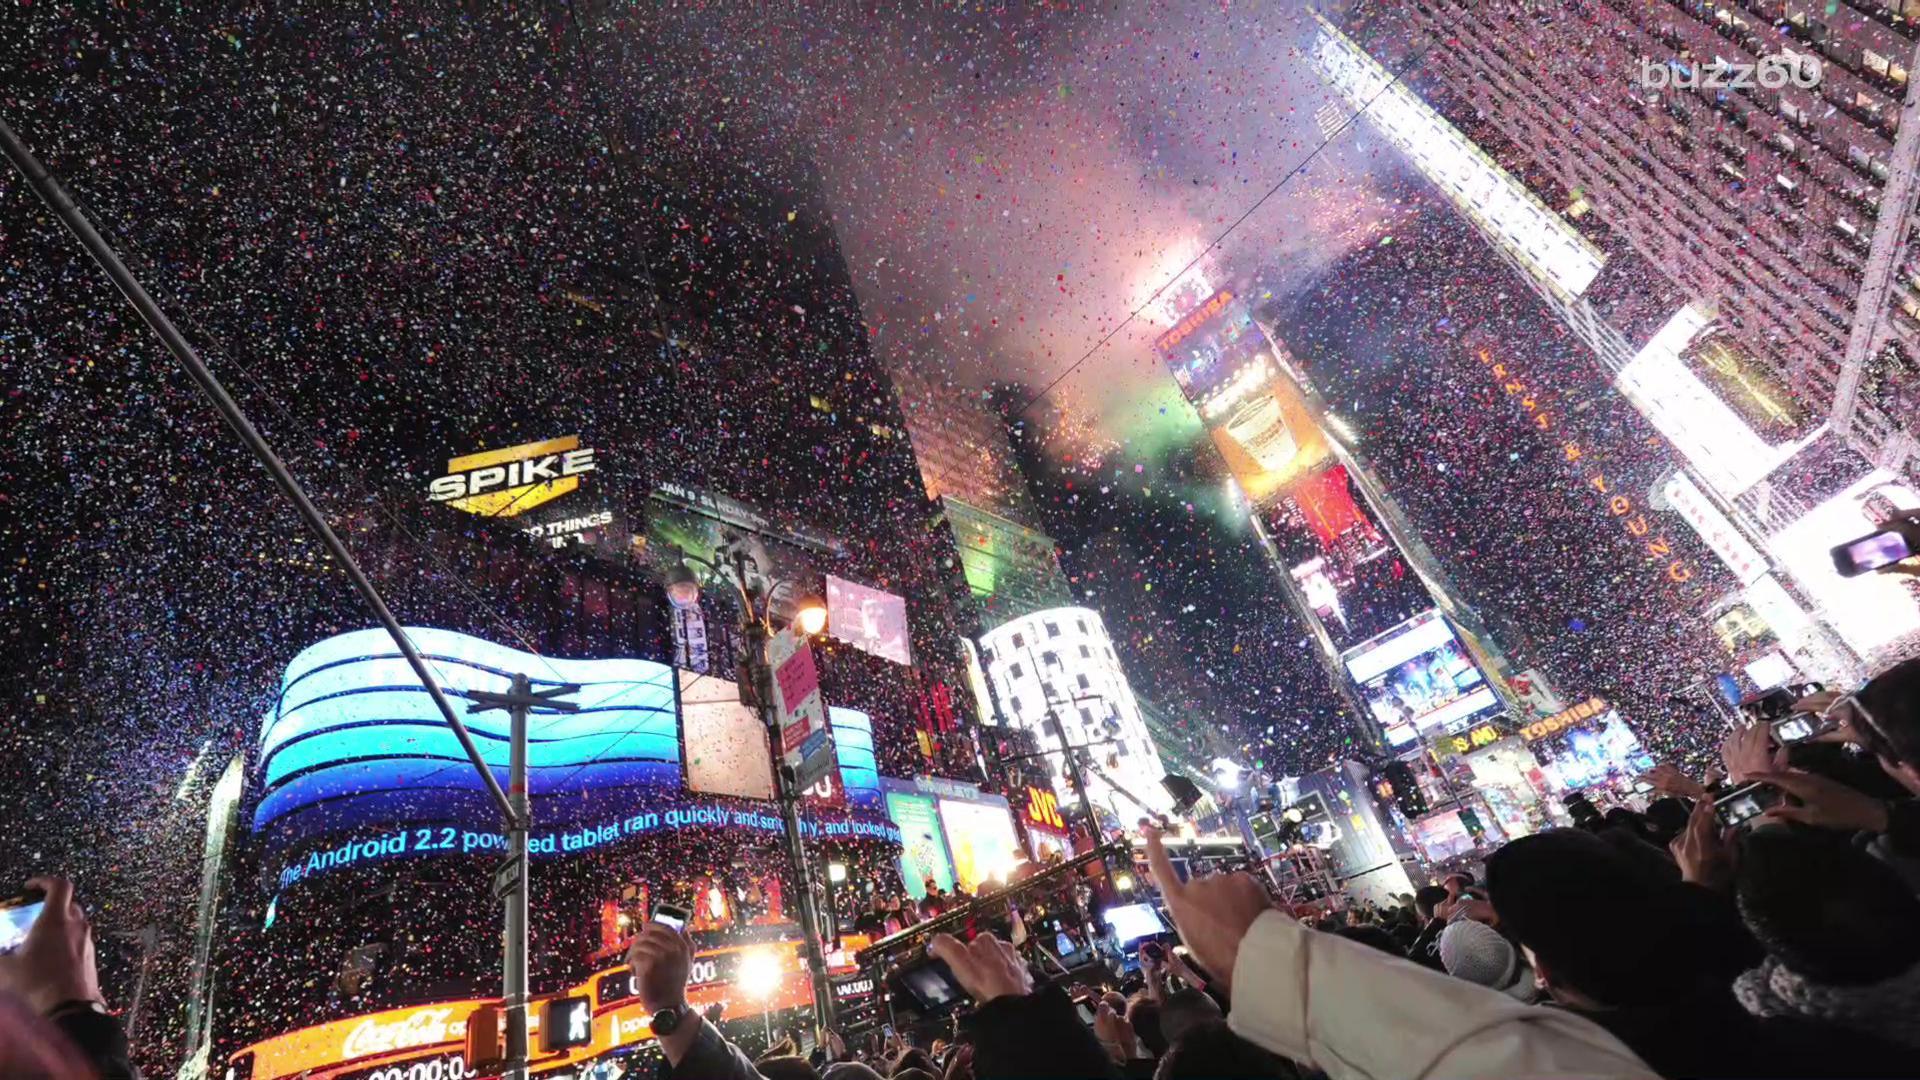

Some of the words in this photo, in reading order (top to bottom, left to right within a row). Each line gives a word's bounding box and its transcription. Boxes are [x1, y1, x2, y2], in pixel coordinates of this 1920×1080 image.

[428, 448, 596, 502] SPIKE
[1478, 347, 1550, 430] ERNST
[1592, 474, 1691, 583] YOUNG
[546, 511, 613, 535] THINGS
[660, 482, 685, 497] JAN
[687, 490, 696, 501] 9
[701, 495, 748, 518] SUNDAY
[1519, 697, 1605, 741] TOSHIBA
[1028, 786, 1064, 829] JVC
[279, 863, 303, 889] The
[306, 831, 408, 873] Android
[414, 827, 455, 850] 2.2
[462, 831, 555, 854] powed
[561, 821, 620, 852] tablet
[624, 807, 659, 831] ran
[665, 805, 729, 829] quickly
[734, 810, 758, 827] and
[825, 817, 849, 834] and
[852, 819, 886, 838] looked
[342, 1008, 454, 1058] Coca-Cola
